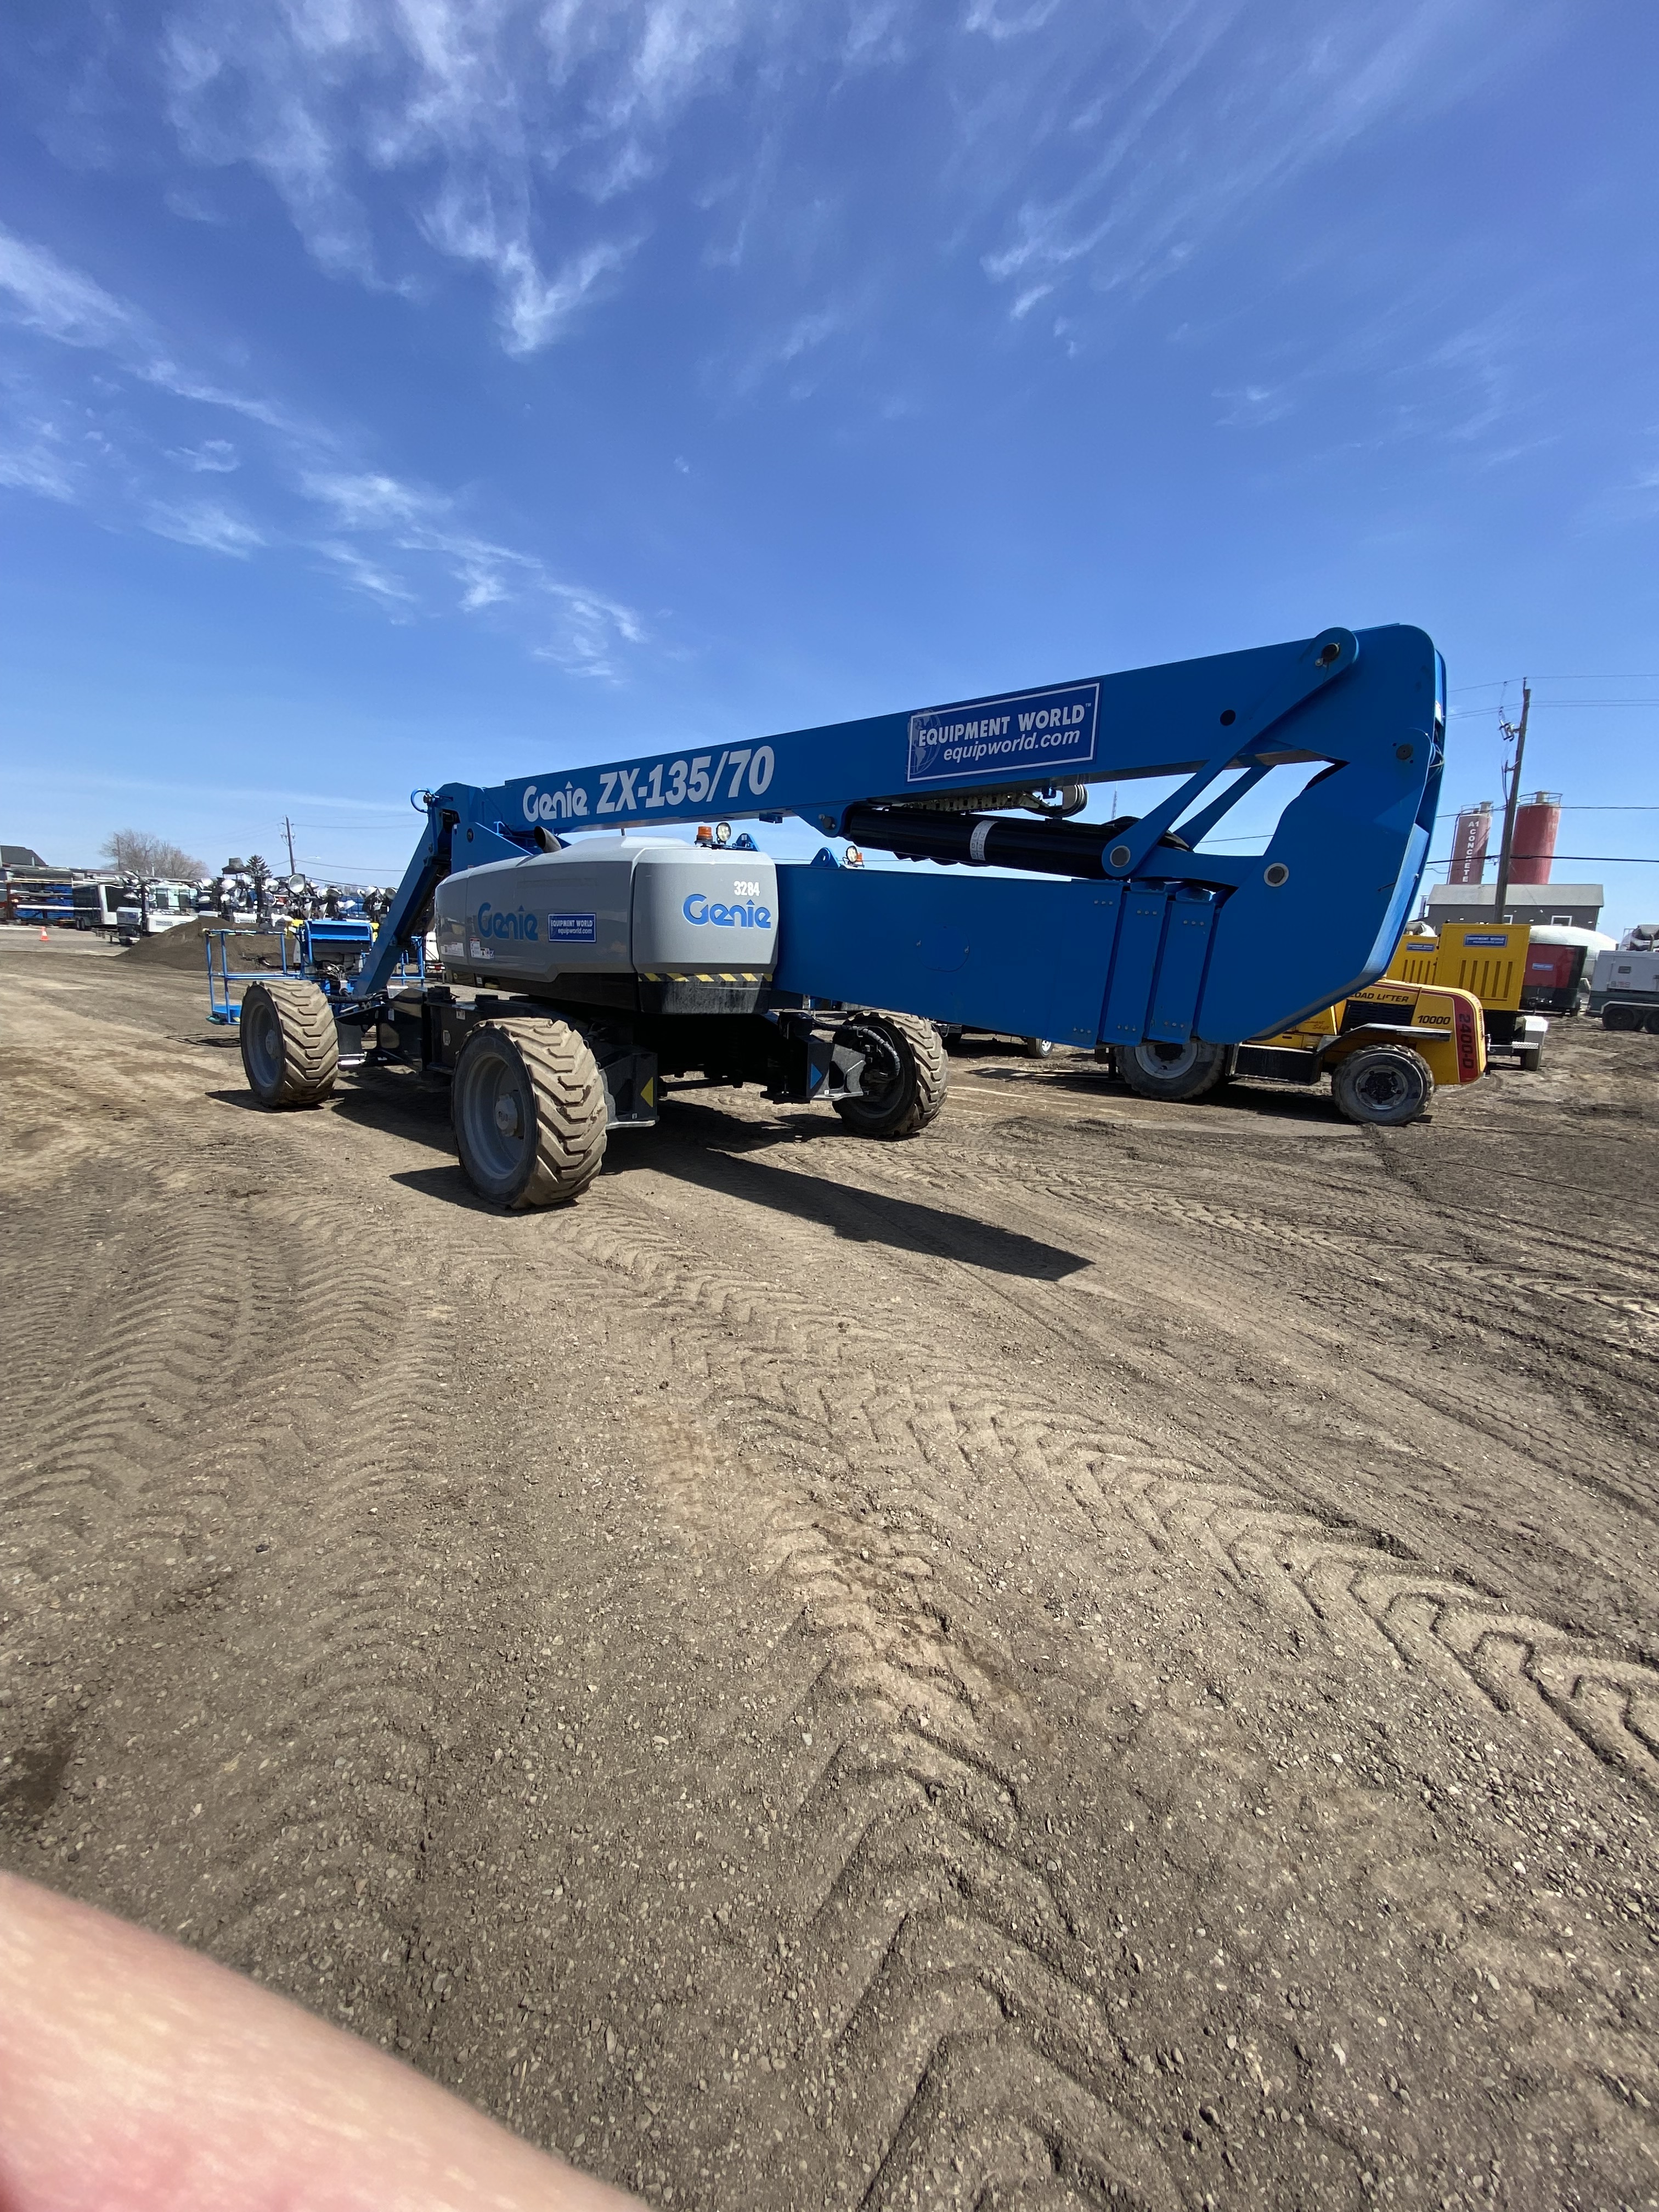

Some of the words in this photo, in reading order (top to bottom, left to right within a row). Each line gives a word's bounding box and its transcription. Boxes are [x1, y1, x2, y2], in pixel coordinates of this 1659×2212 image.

[918, 716, 1011, 747] EQUIPMENT
[1018, 704, 1085, 731] WORLD
[943, 730, 1081, 763] equipworld.com
[523, 781, 588, 822] Genie
[596, 746, 775, 814] ZX-135/70
[733, 881, 760, 896] 3284
[477, 902, 538, 941] Genie
[682, 893, 772, 929] Genie
[1418, 1015, 1451, 1025] 10000
[1459, 1014, 1475, 1069] 2400-D
